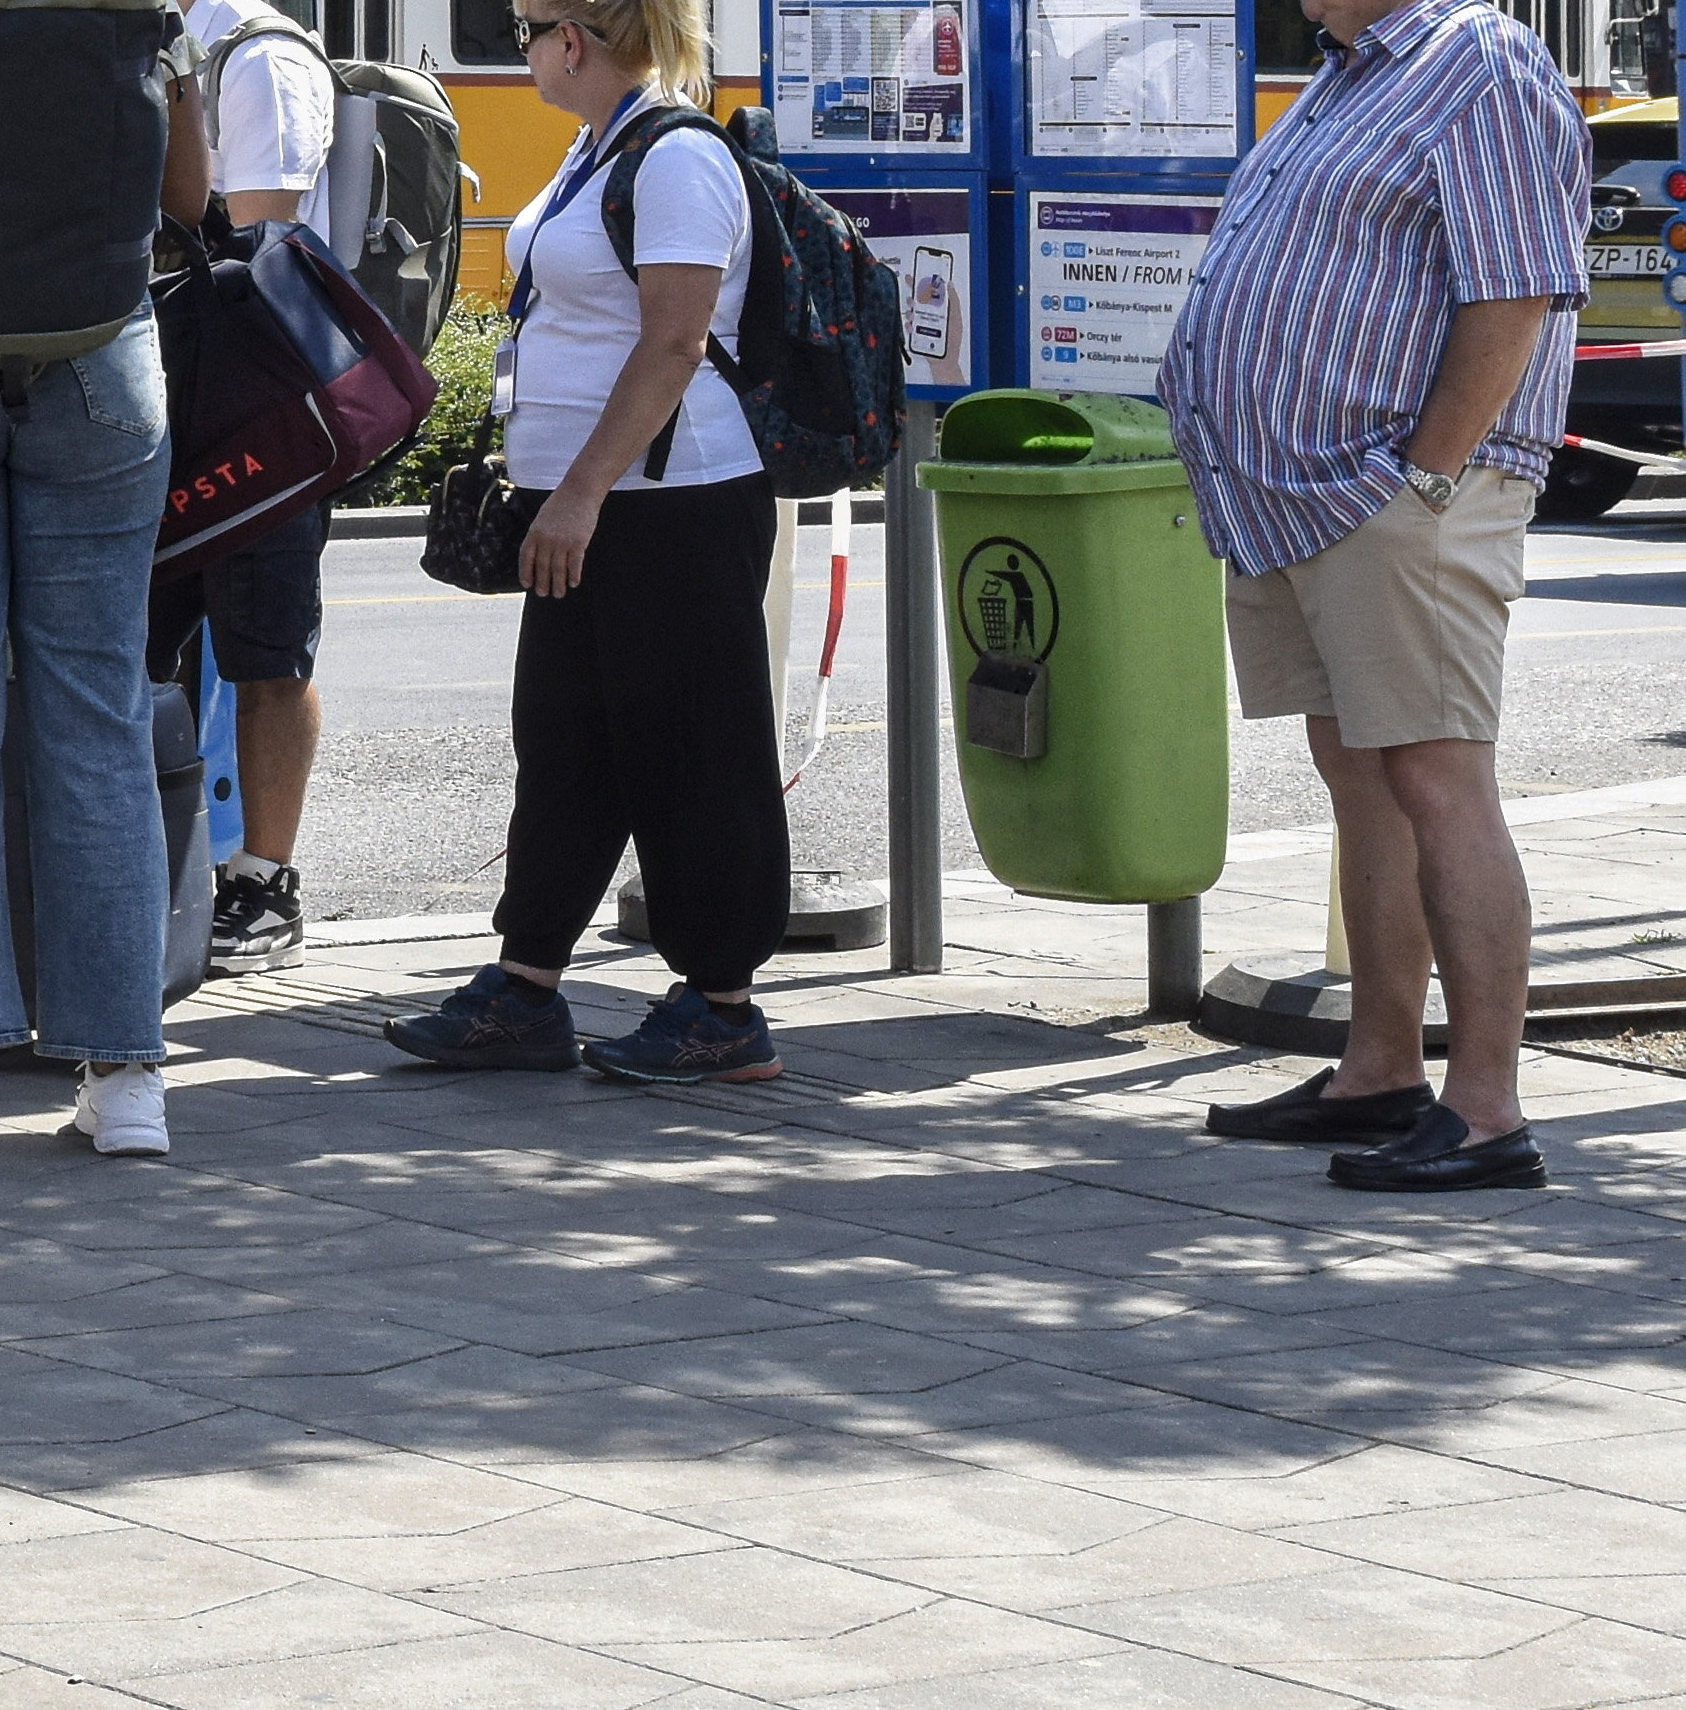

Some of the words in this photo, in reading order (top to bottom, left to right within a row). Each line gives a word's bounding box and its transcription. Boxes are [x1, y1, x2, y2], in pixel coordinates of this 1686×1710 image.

[853, 216, 870, 228] GO
[1095, 246, 1114, 256] Liszt
[1115, 247, 1142, 258] Ferenc
[1143, 247, 1173, 260] Airport
[1175, 249, 1180, 259] 2
[1582, 247, 1673, 272] ZP-164
[1063, 262, 1118, 283] INNEN
[1122, 265, 1129, 283] /
[1133, 265, 1182, 286] FROM
[1086, 331, 1110, 344] Orczy
[1111, 333, 1123, 343] tér
[1087, 351, 1122, 364] Kőbánya
[161, 453, 264, 523] PSTA
